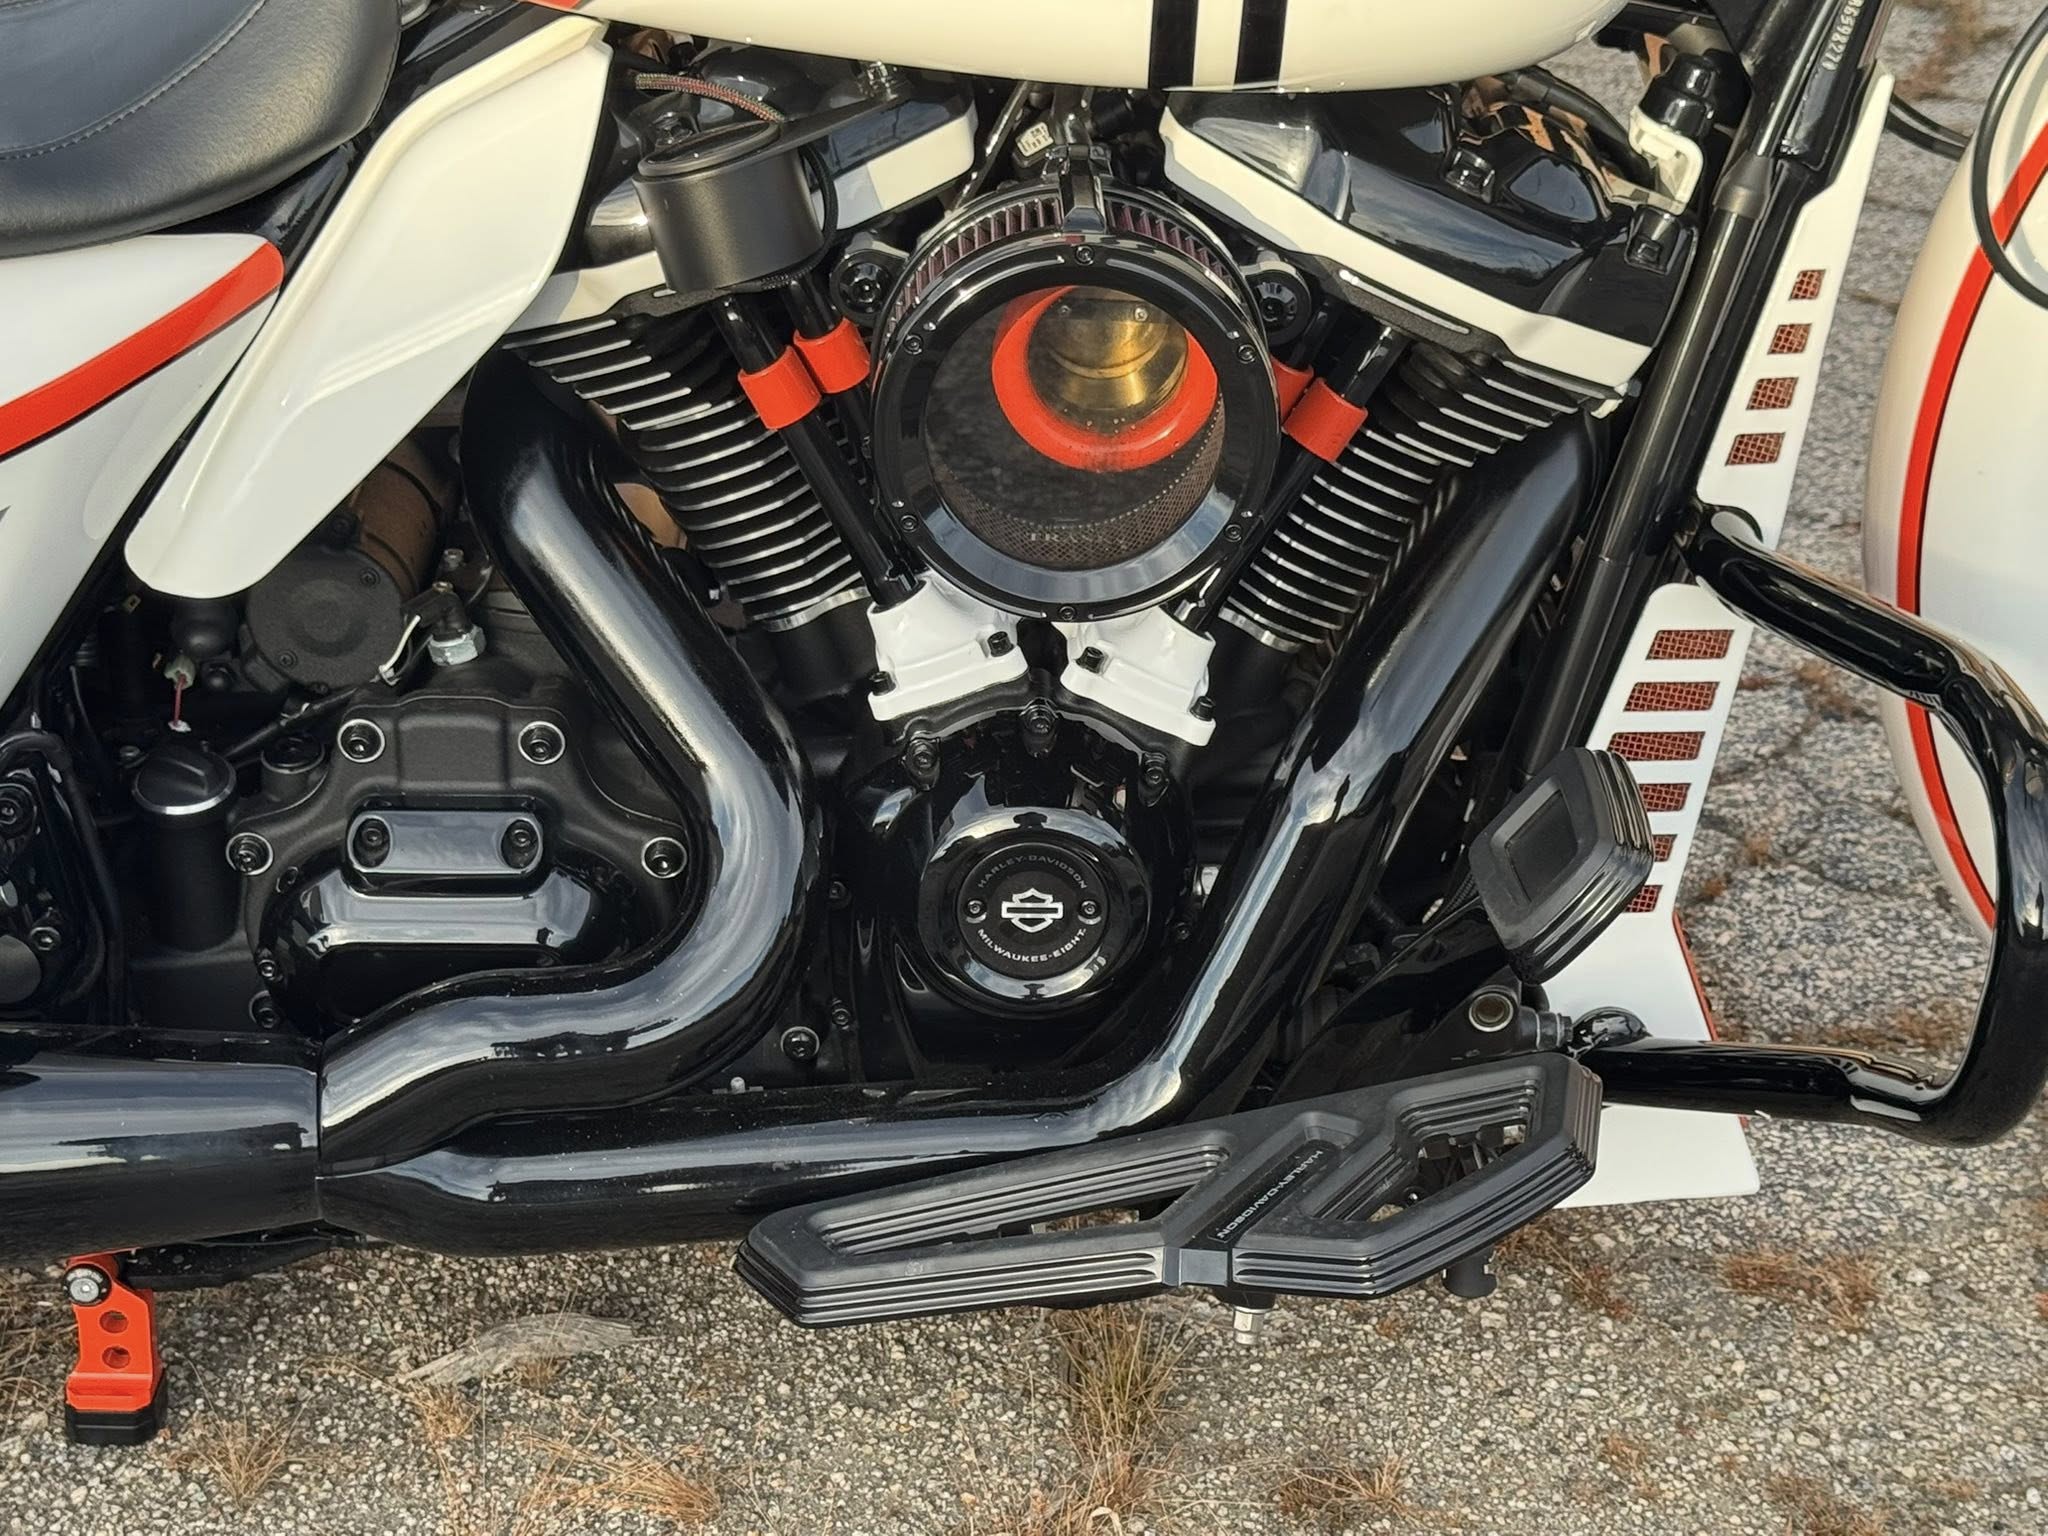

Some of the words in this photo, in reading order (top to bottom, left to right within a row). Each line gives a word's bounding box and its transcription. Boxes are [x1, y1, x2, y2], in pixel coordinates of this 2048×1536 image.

[978, 855, 1088, 889] HARLEY-DAVIDSON
[977, 928, 1087, 962] MILWAUKEE-EIGHT
[1217, 1150, 1324, 1238] HARLEY-DAVIDSON
